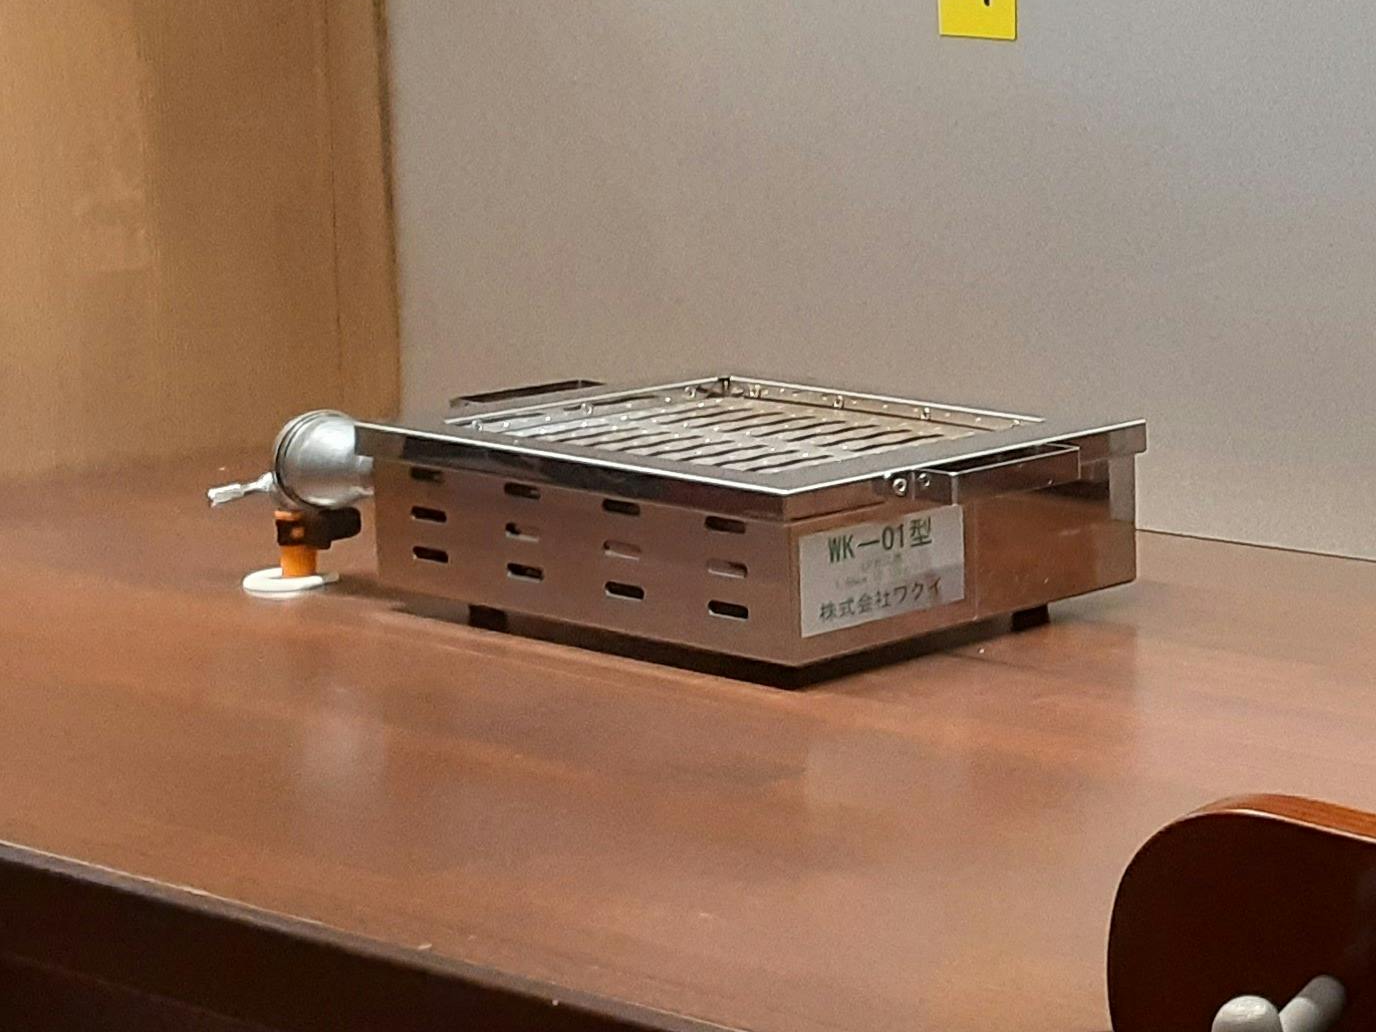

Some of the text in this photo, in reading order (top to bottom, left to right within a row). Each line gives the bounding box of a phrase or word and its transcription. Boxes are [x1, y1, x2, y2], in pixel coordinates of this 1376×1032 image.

[819, 576, 942, 622] 株式会社ワクイ
